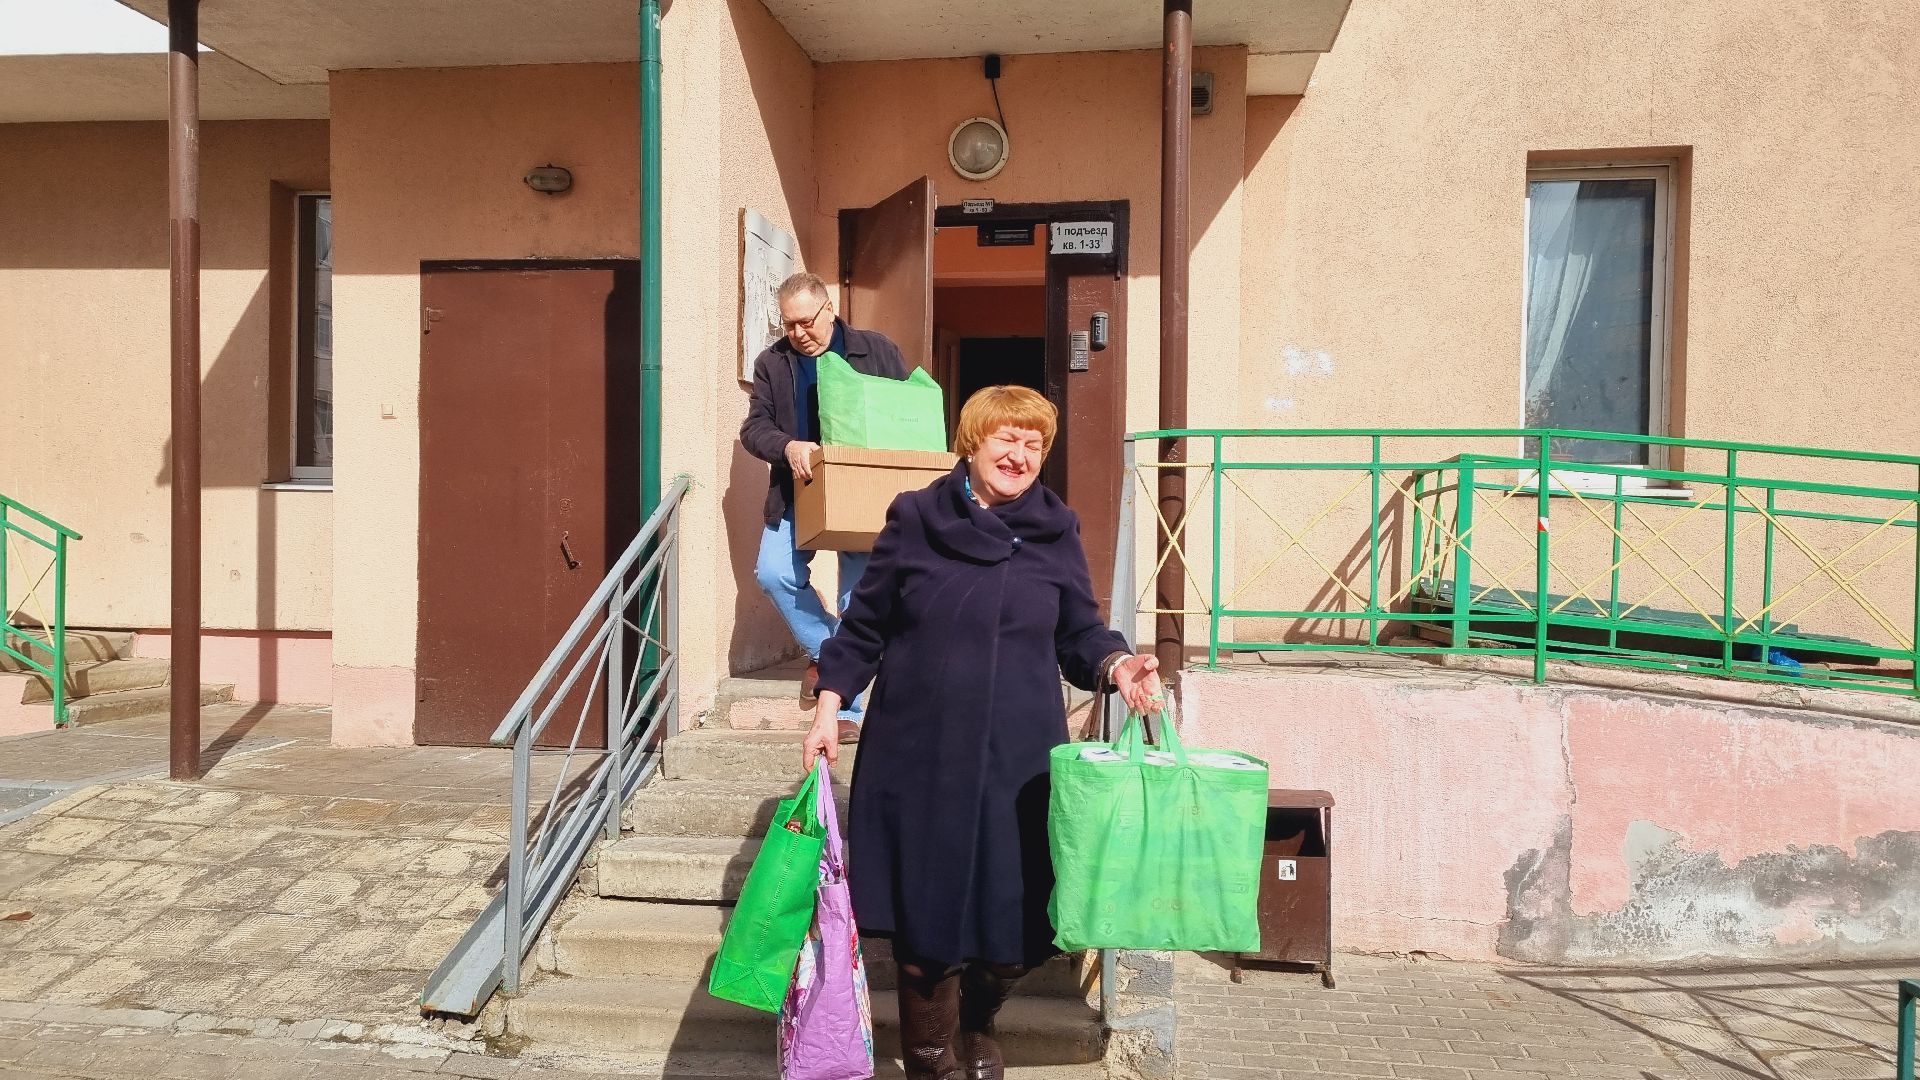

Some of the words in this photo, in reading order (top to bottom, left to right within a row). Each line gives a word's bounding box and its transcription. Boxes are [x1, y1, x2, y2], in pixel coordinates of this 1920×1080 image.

[1056, 226, 1061, 236] 1
[1064, 227, 1108, 237] подъезд
[1063, 241, 1077, 250] кв.
[1080, 239, 1101, 249] 1-33
